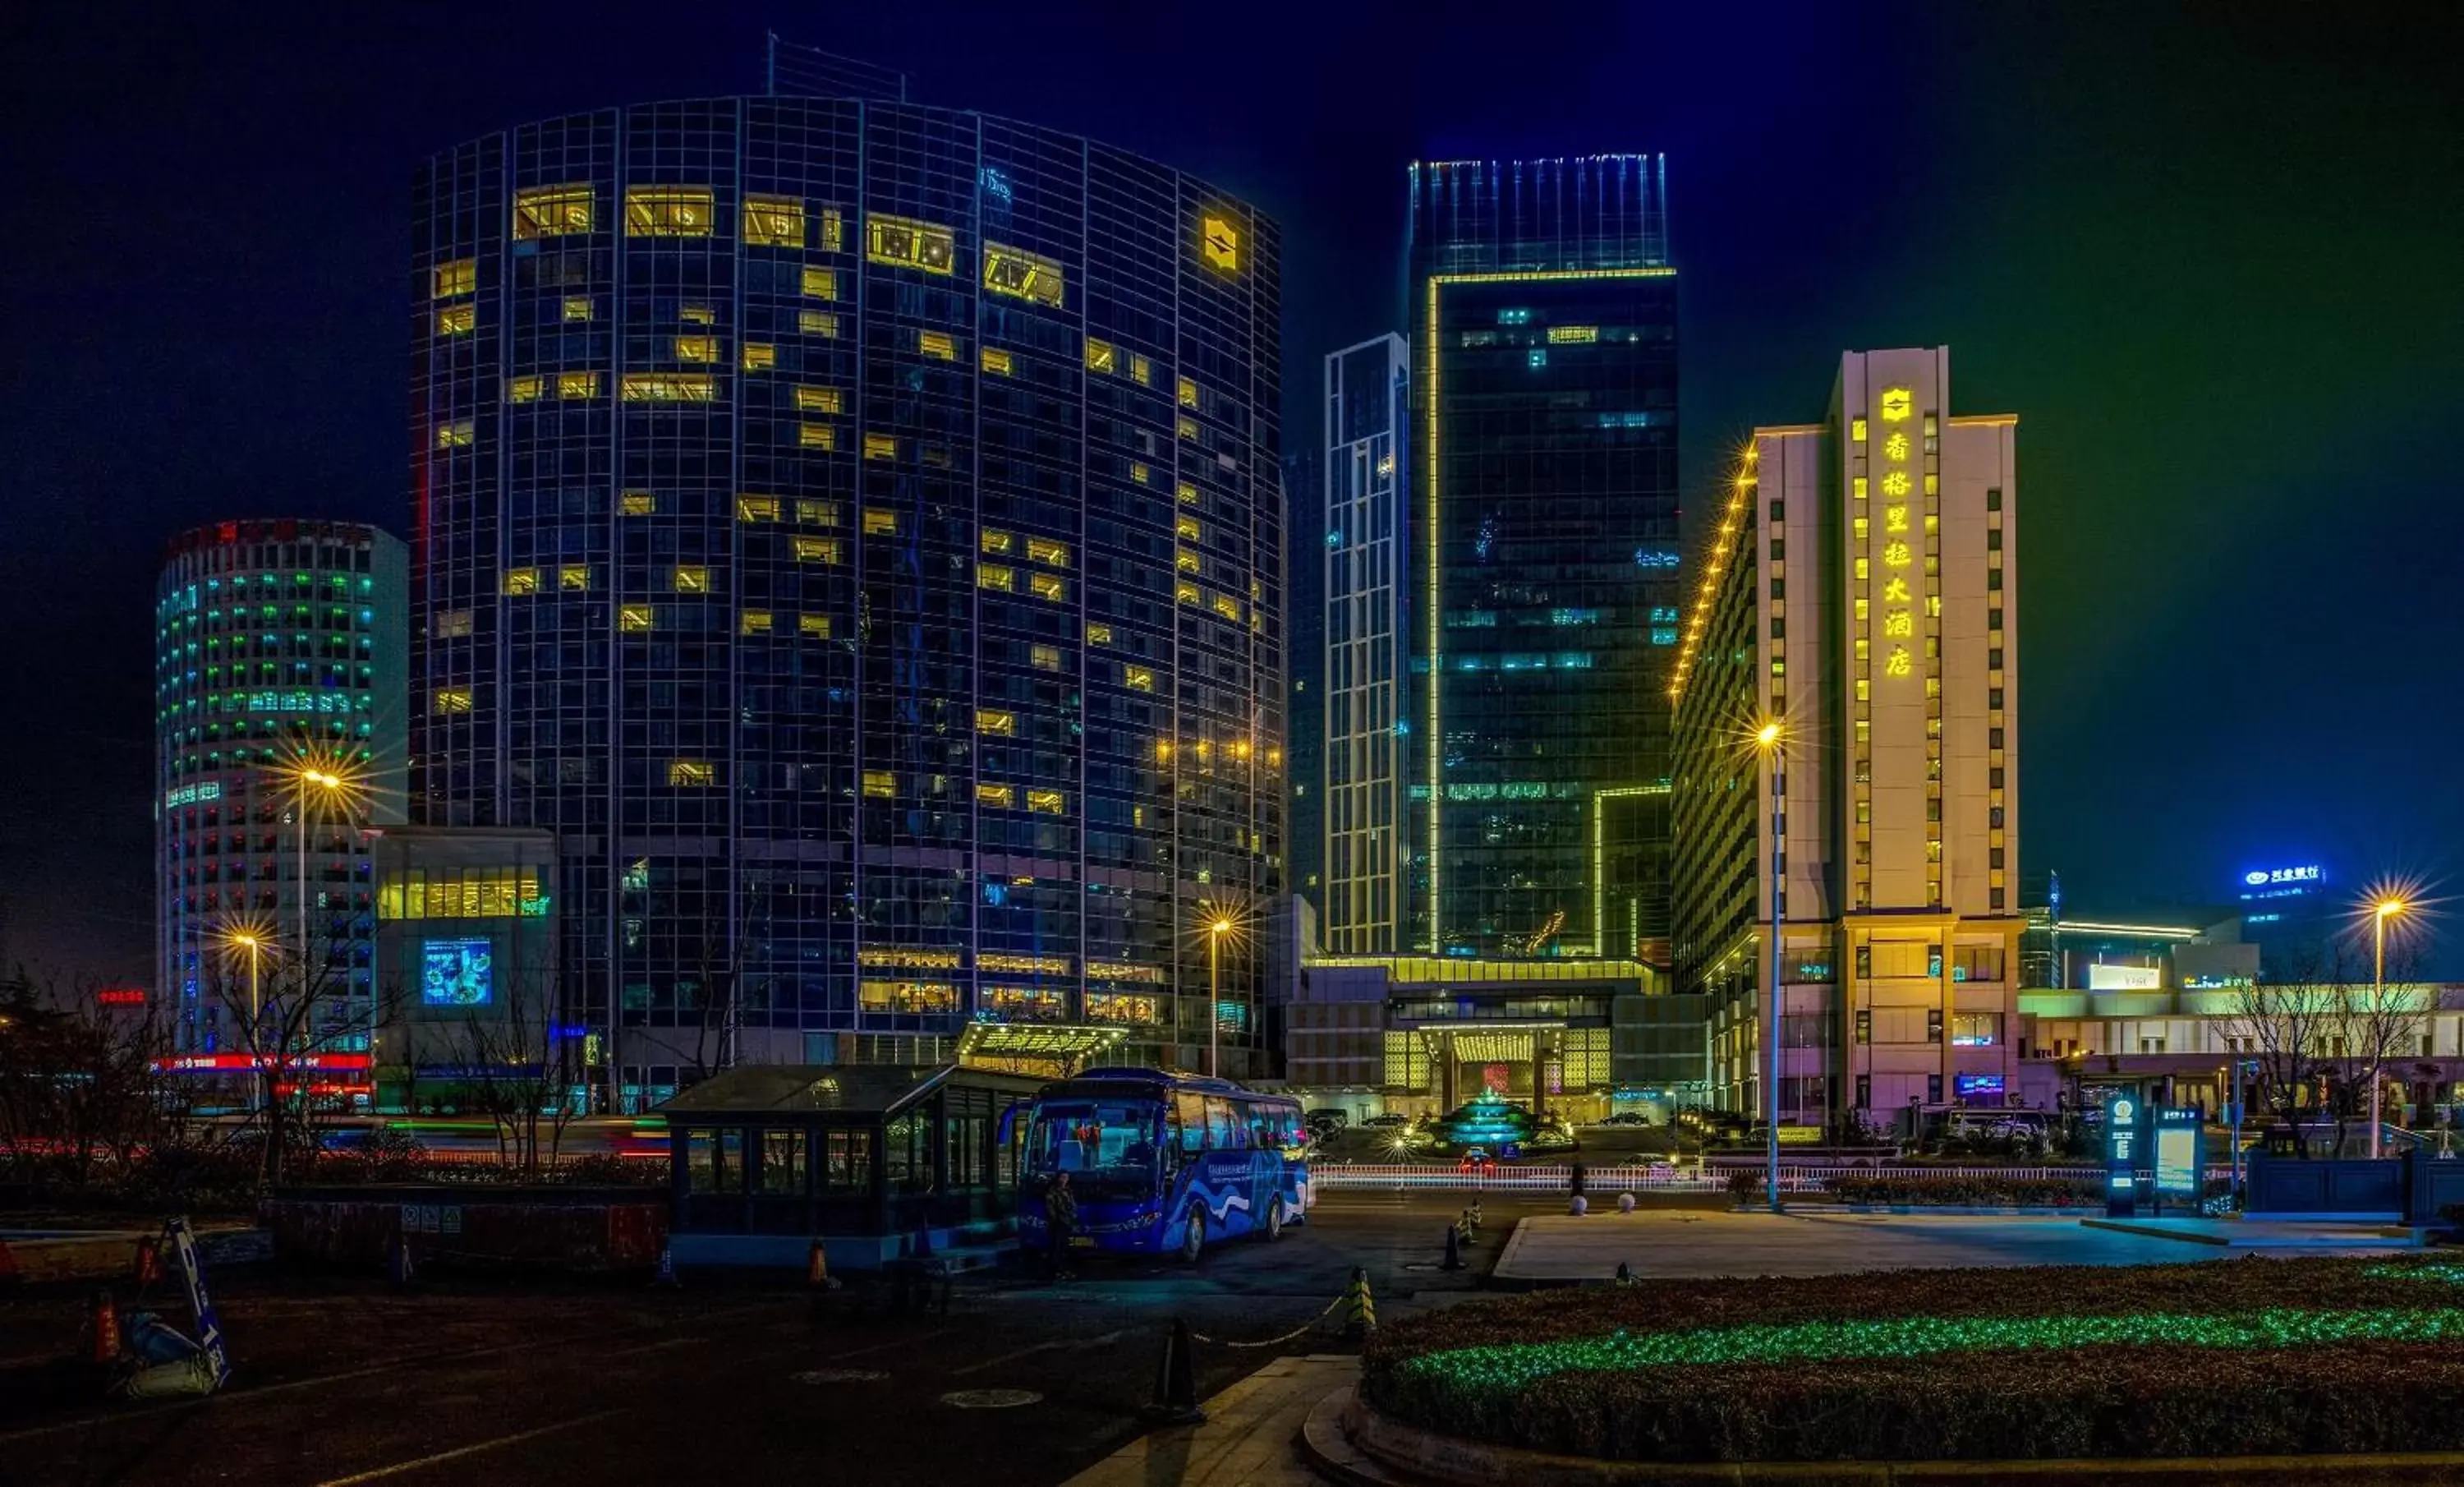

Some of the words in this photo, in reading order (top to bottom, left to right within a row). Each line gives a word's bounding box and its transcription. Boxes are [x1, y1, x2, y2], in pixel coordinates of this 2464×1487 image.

[1882, 433, 1912, 676] 香格里拉大酒店
